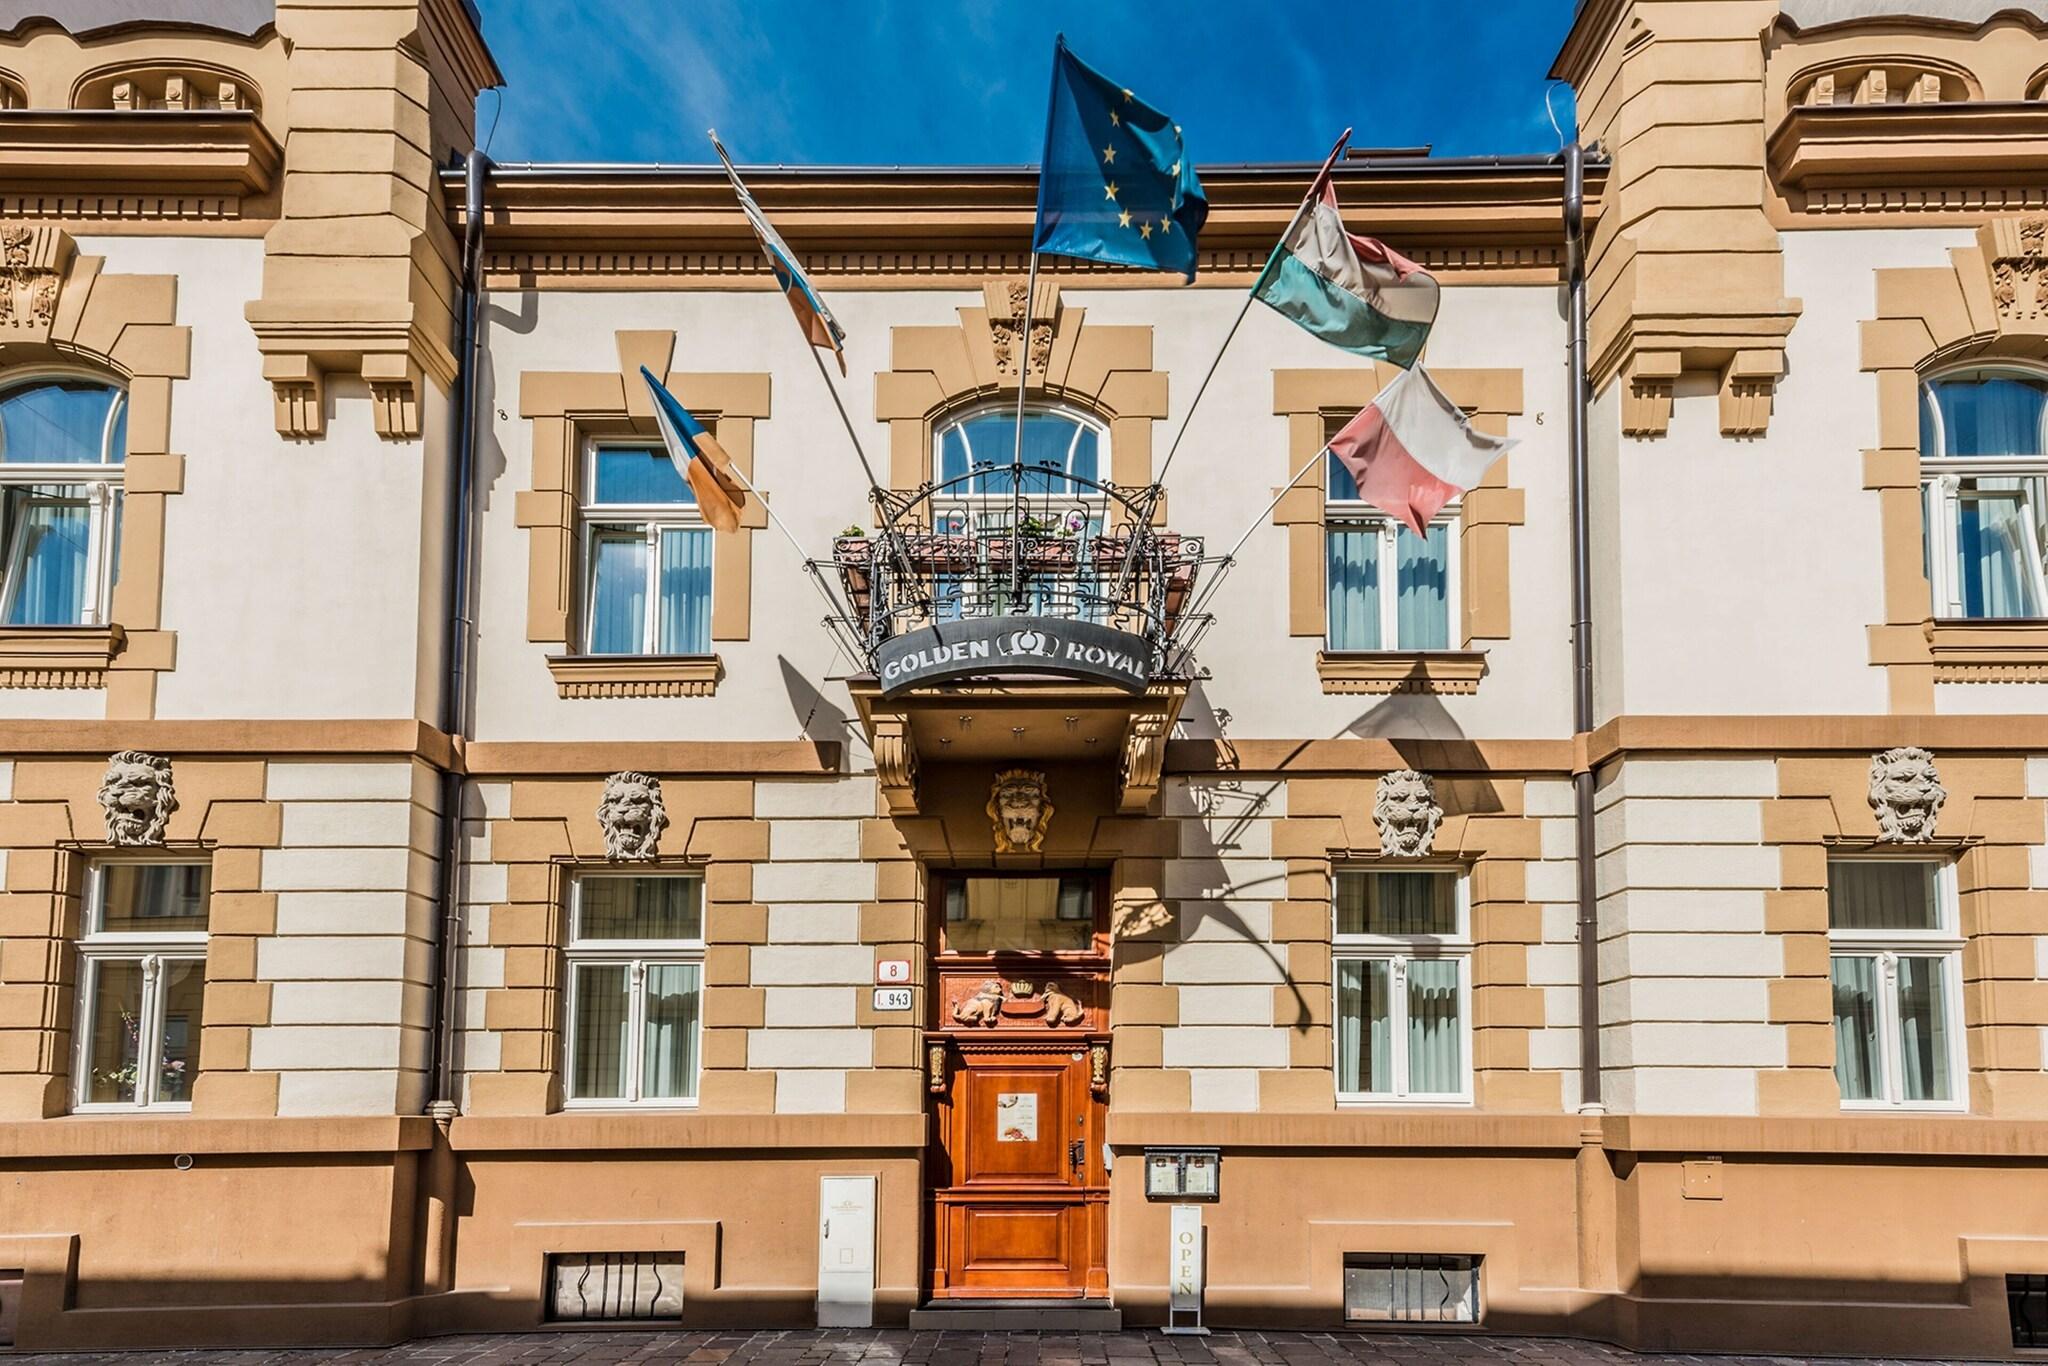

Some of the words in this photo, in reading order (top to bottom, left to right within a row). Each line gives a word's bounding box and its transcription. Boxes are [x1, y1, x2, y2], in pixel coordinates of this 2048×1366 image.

[884, 639, 990, 681] GOLDEN
[1066, 642, 1146, 680] ROYAL
[890, 964, 897, 977] 8
[889, 993, 908, 1006] 943
[1179, 1231, 1194, 1296] OPEN
